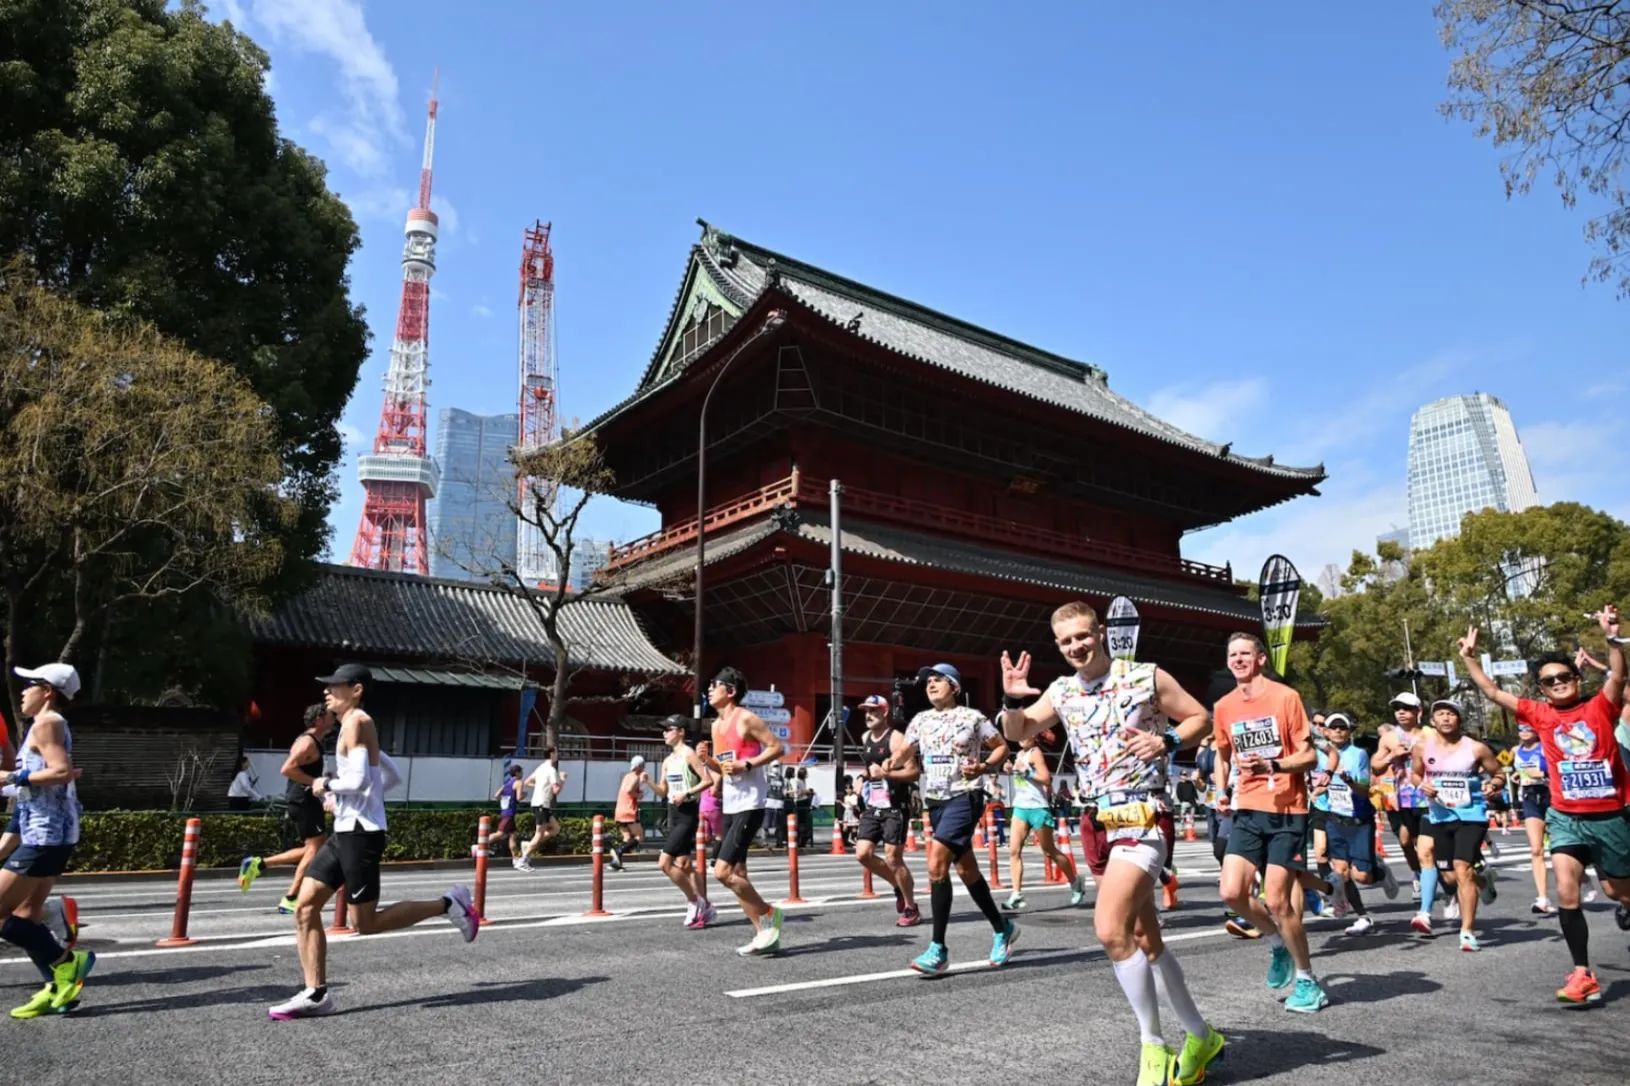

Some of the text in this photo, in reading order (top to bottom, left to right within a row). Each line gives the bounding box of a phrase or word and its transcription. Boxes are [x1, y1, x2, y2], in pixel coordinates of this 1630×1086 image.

[1264, 604, 1291, 622] 3:20
[1111, 636, 1134, 651] 3:20
[1242, 730, 1274, 748] 12603
[1570, 773, 1605, 787] 21931
